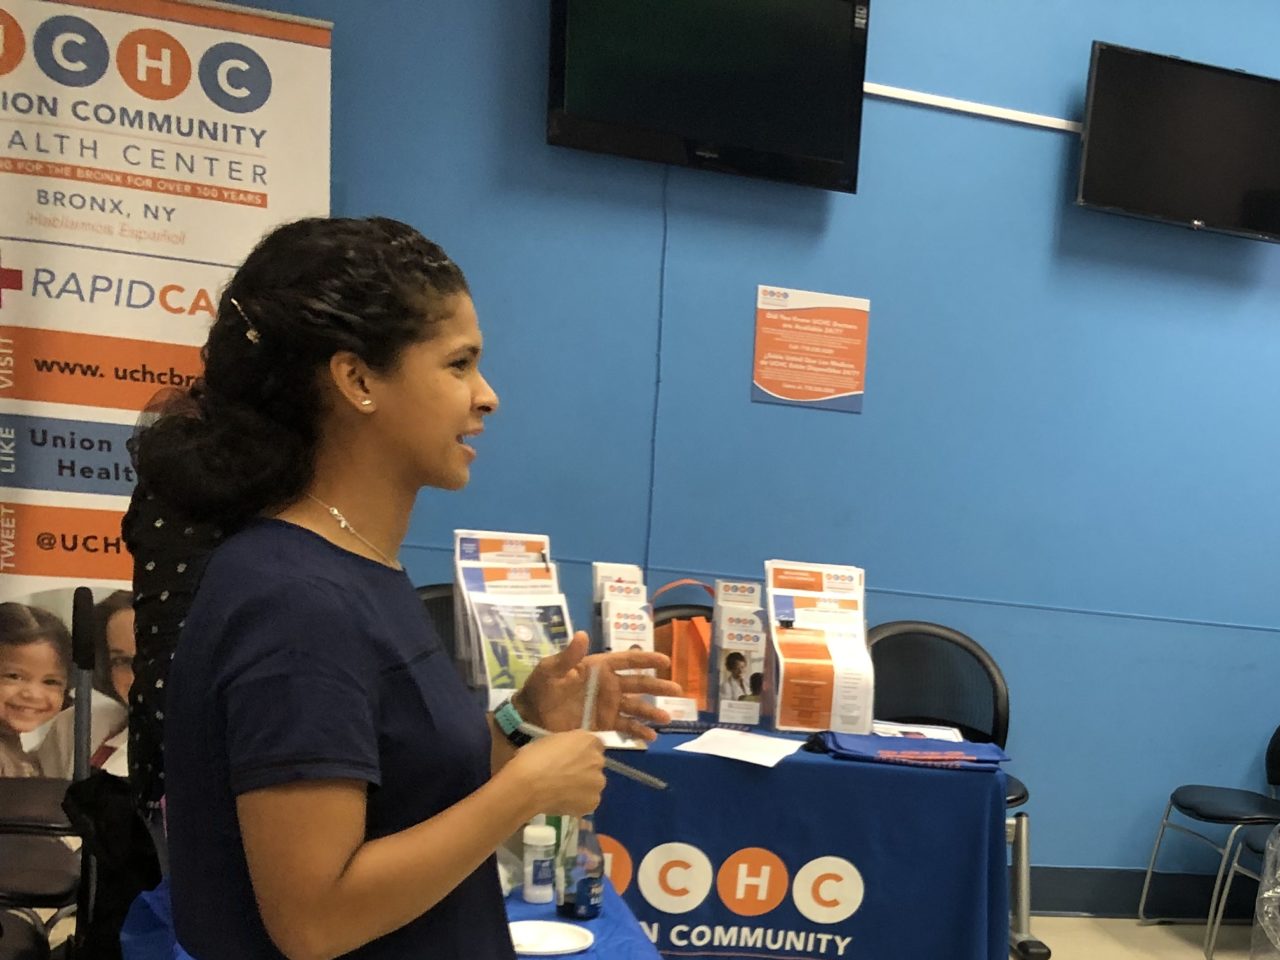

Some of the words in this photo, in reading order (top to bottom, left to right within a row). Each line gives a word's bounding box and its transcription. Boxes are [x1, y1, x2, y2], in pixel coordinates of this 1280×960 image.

[2, 88, 58, 117] ION
[72, 101, 267, 148] COMMUNITY
[8, 130, 98, 159] ALTH
[123, 145, 267, 185] CENTER
[76, 168, 122, 182] BRONX
[127, 174, 152, 187] FOR
[157, 181, 191, 193] OVER
[222, 189, 262, 204] YEARS
[37, 189, 131, 218] BRONX,
[144, 204, 176, 221] NY
[31, 268, 217, 318] RAPIDCA
[34, 358, 104, 378] www.
[0, 427, 15, 473] LIKE
[29, 428, 112, 452] Union
[57, 459, 134, 482] Healt
[0, 504, 16, 570] TWEET
[36, 531, 120, 554] @UCH
[670, 924, 852, 956] COMMUNITY
